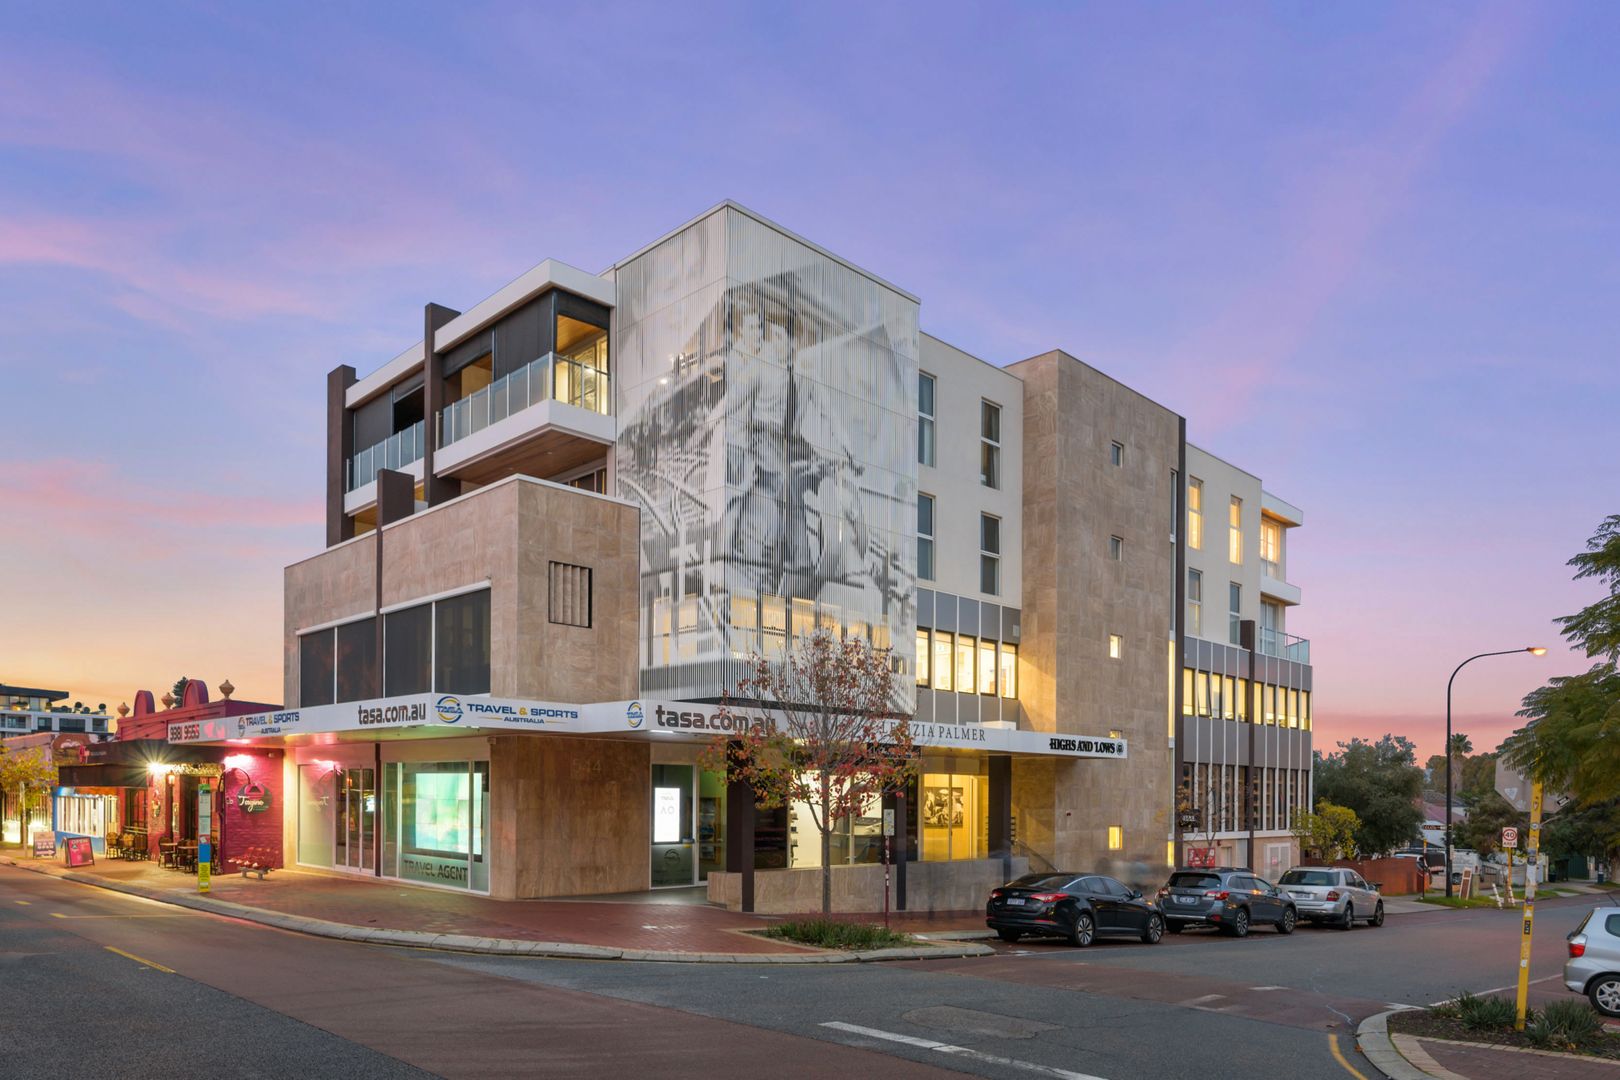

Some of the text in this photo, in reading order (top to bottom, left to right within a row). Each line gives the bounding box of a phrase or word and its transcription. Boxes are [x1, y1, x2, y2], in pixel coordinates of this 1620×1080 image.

[358, 703, 426, 725] tasa.com.au
[467, 703, 578, 719] TRAVEL & SPORTS
[246, 715, 267, 727] TRAVEL
[268, 714, 273, 725] &
[274, 712, 300, 723] SPORTS
[656, 704, 776, 736] tasa.comau
[938, 726, 986, 741] PALMER
[1050, 738, 1115, 754] HIGHS AND LOWS
[404, 860, 468, 882] TRAVEL AGENT
